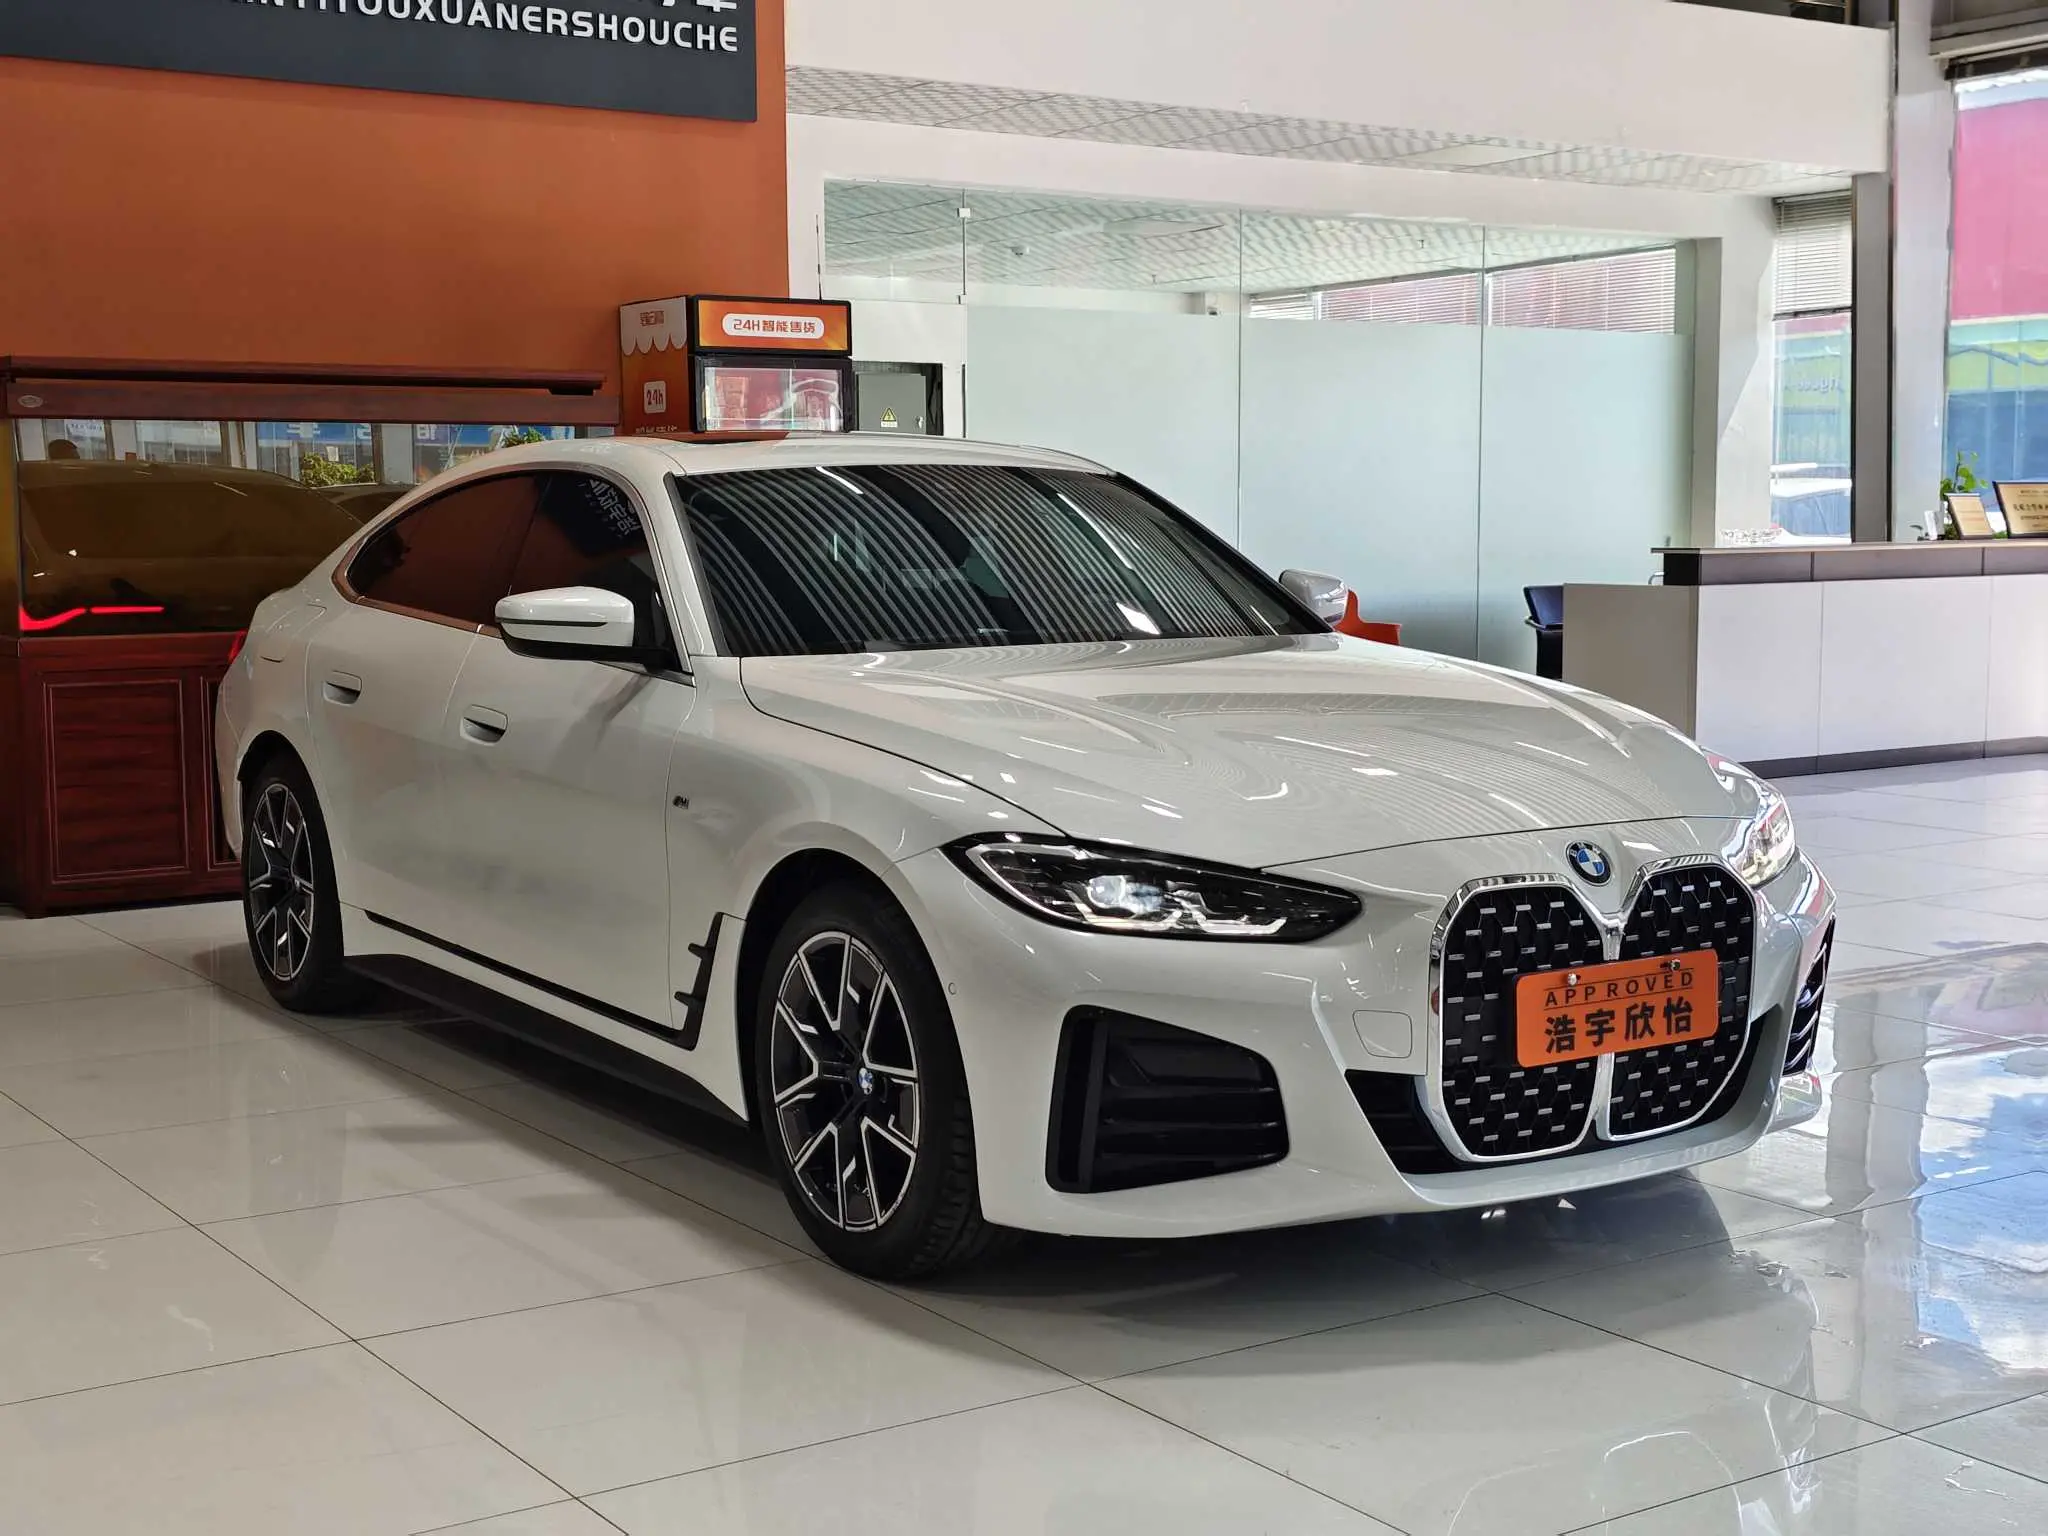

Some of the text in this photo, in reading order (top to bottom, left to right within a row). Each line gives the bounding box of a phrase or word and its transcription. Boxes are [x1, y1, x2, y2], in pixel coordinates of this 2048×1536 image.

[1545, 971, 1693, 1007] APPROVED
[1544, 996, 1694, 1054] 浩宇欣怡
